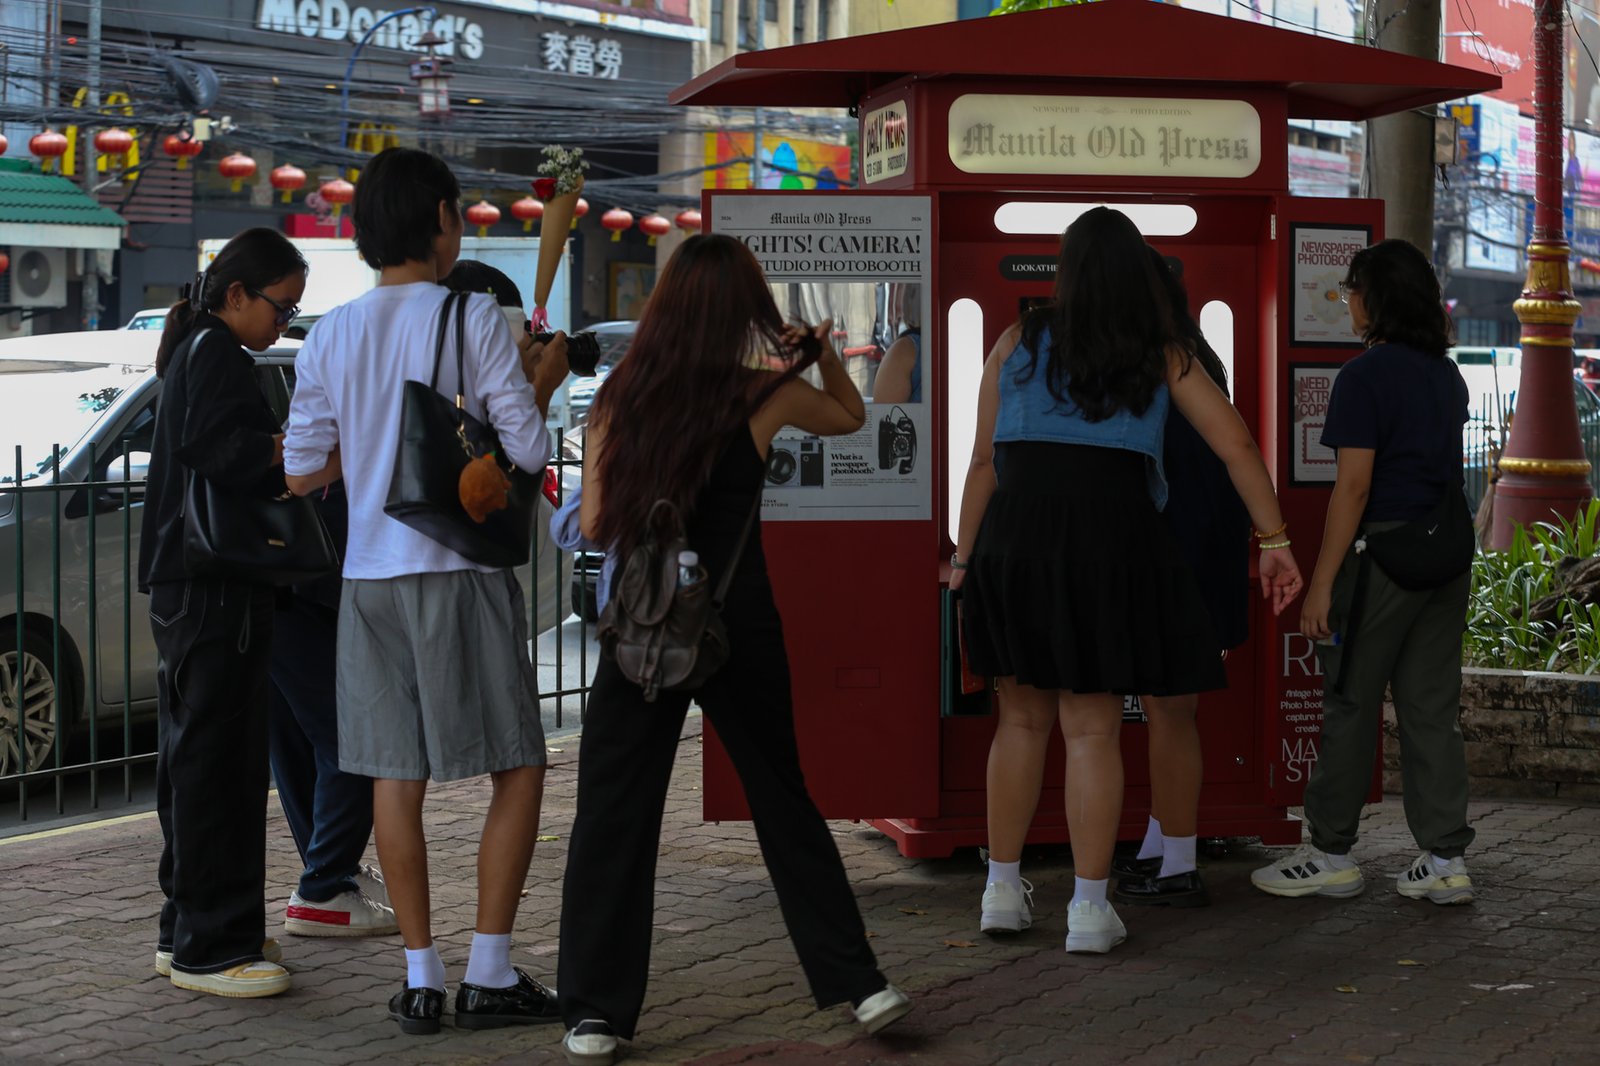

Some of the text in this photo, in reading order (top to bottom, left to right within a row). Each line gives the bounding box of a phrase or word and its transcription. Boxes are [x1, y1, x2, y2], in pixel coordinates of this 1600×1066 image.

[257, 0, 484, 60] McDonald's
[541, 31, 623, 80] 麥當勞
[1032, 106, 1080, 114] NEWSPAPER
[885, 110, 906, 151] NEWS
[962, 122, 1077, 158] Manila
[1087, 125, 1146, 158] Old
[1158, 126, 1249, 167] Press
[769, 212, 872, 226] Manila Old Press
[736, 234, 921, 254] GHTS! CAMERA!
[1301, 241, 1362, 255] NEWSPAPER
[757, 259, 921, 272] TUDIO PHOTOBOOTH
[1297, 253, 1352, 266] PHOTOBOO
[1300, 376, 1330, 389] NEED
[1299, 390, 1329, 403] EXTR
[1300, 403, 1328, 417] COPI
[831, 461, 869, 469] newspaper
[831, 467, 875, 477] photobooth?
[1280, 701, 1324, 710] Photo Boot
[1285, 712, 1316, 723] capture
[1295, 724, 1320, 733] create
